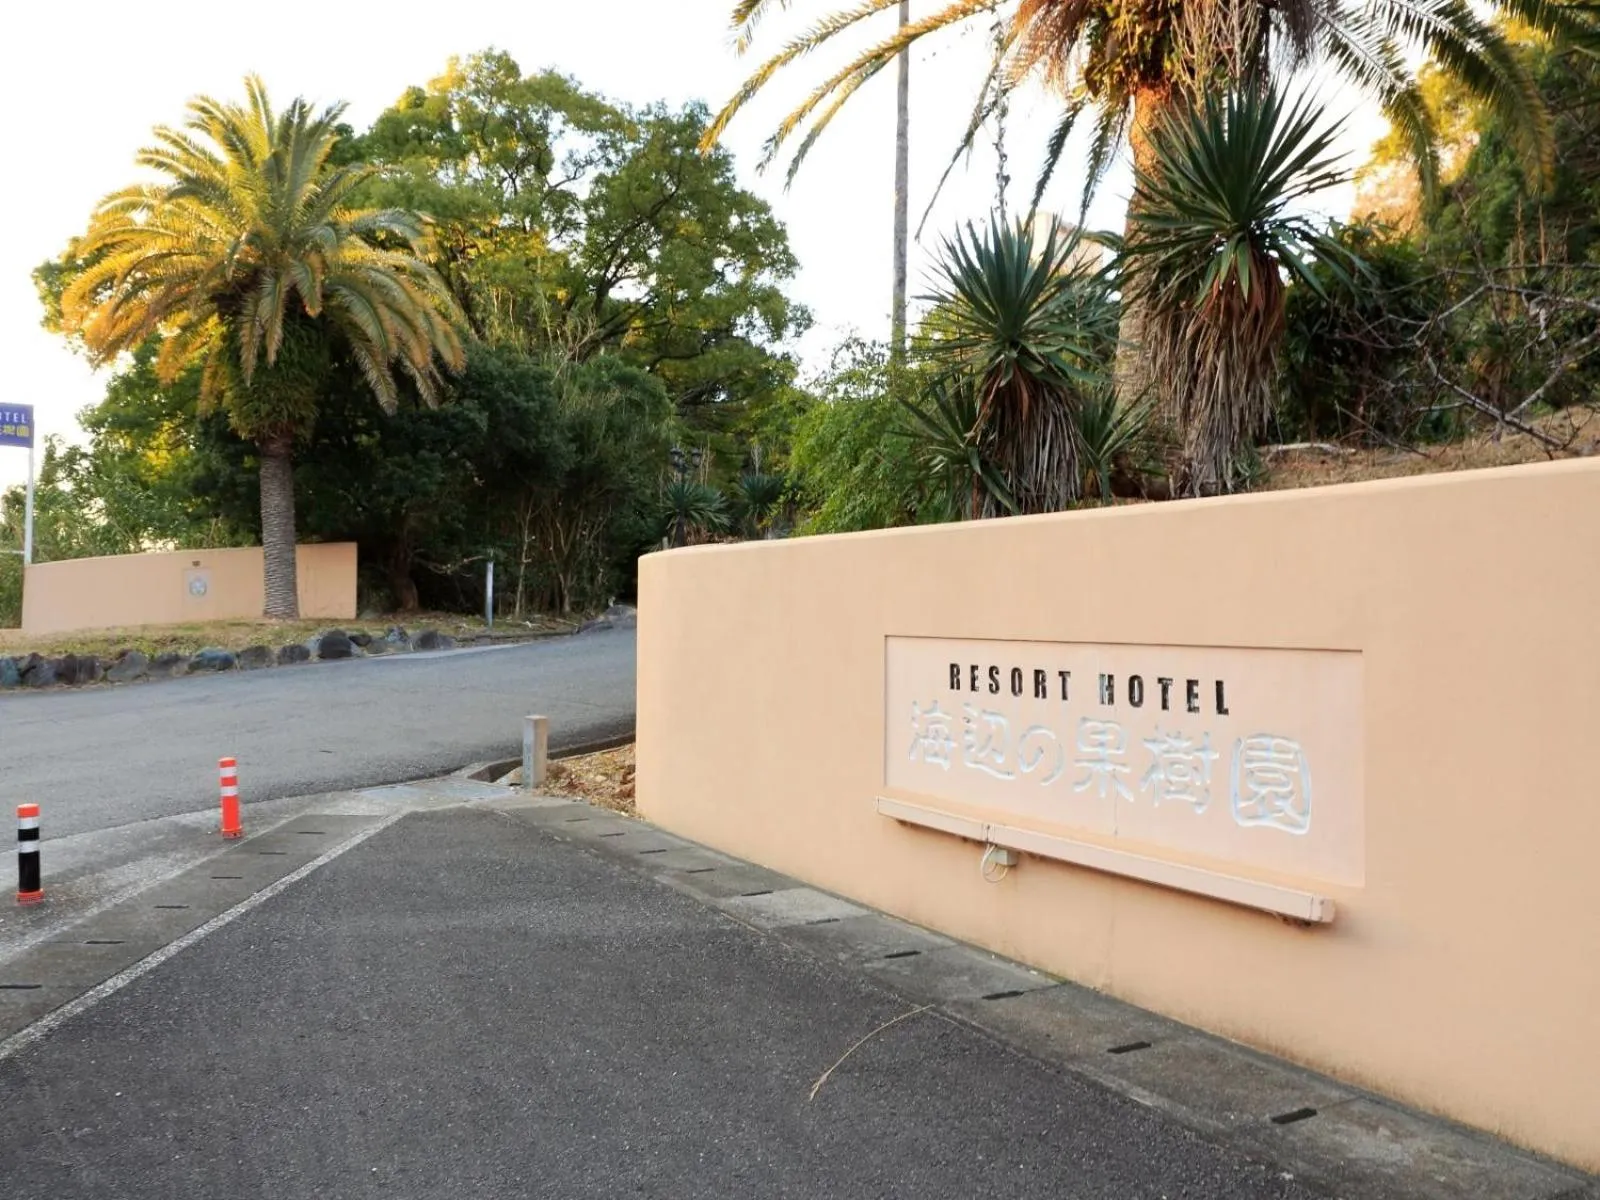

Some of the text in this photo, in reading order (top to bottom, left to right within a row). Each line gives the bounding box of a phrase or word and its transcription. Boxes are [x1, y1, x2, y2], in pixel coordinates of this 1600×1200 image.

[949, 663, 1230, 715] RESORT HOTEL
[909, 700, 1312, 835] 海辺の果樹園
